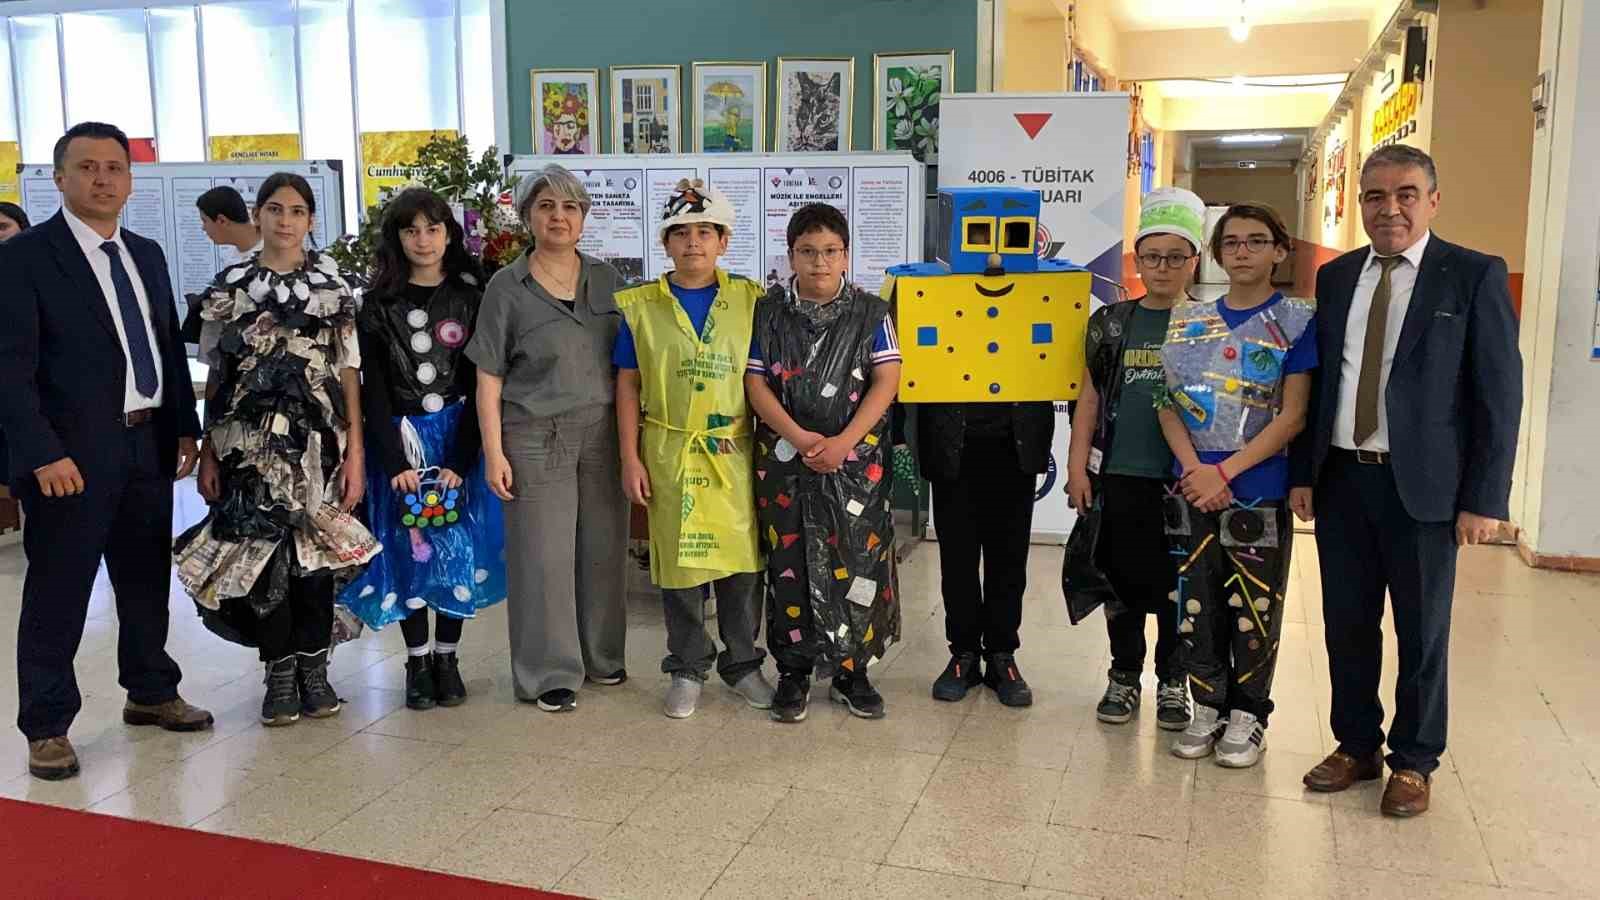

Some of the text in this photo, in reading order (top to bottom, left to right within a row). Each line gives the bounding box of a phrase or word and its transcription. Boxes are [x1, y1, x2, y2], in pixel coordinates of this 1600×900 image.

[967, 169, 1006, 183] 4006
[1021, 166, 1095, 183] TÜBİTAK
[1033, 190, 1082, 203] UARI
